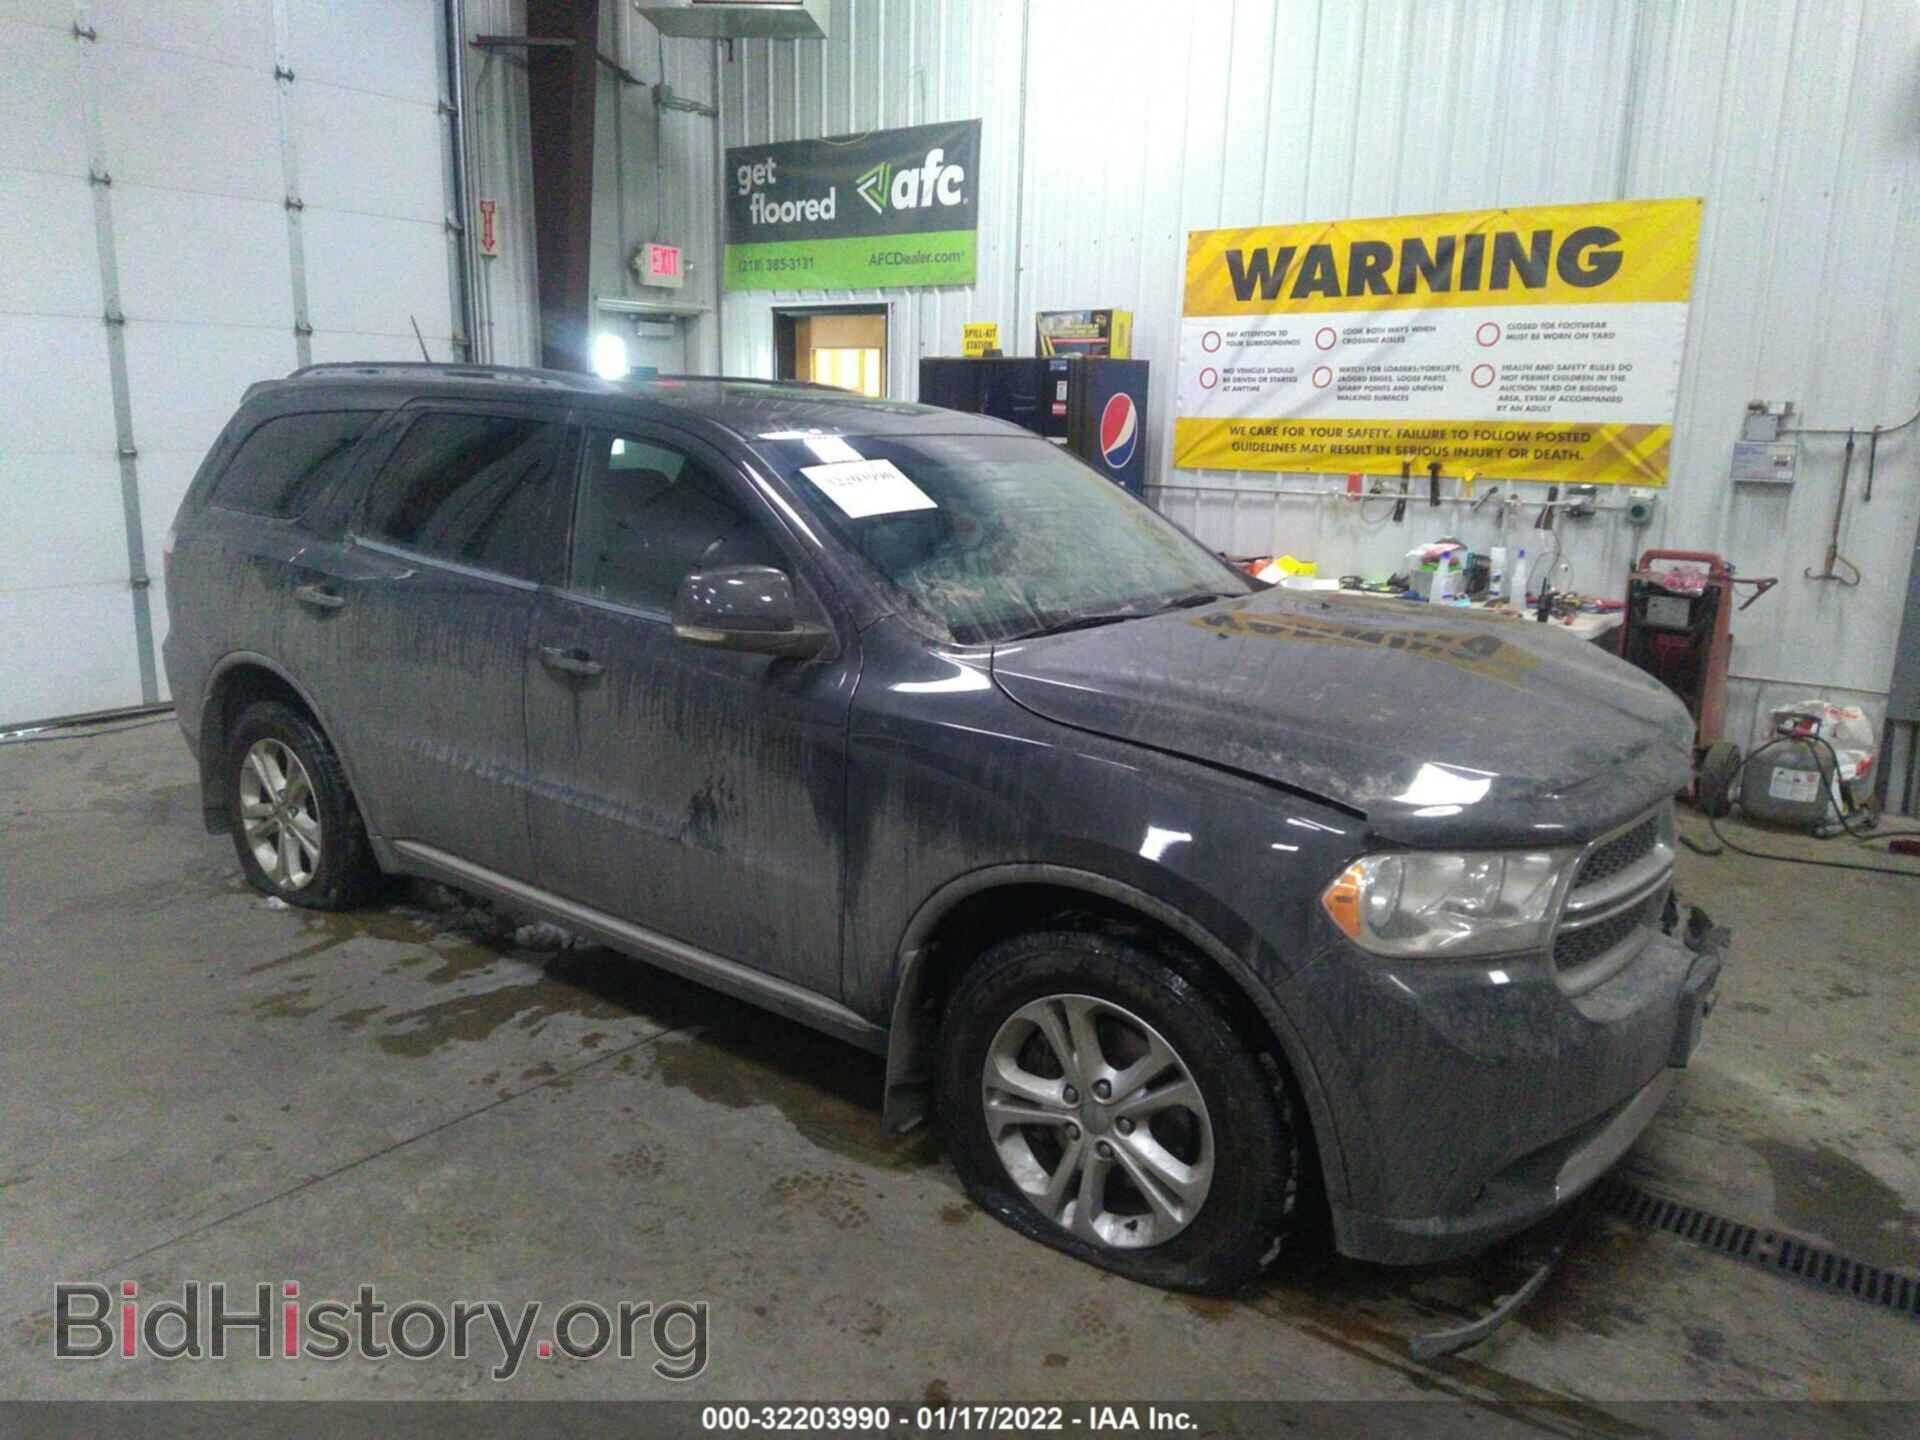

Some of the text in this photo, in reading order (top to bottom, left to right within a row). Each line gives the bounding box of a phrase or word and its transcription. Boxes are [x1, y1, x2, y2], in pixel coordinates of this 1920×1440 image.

[737, 157, 776, 195] get
[891, 149, 965, 209] afc
[750, 187, 836, 225] floored
[652, 247, 678, 274] EXIT
[868, 250, 961, 267] AFCDealer.com
[1225, 226, 1623, 300] WARNING
[1230, 426, 1590, 442] WE CARE FOR YOUR SAFETY. FAILURE TO FOLLOW POSTED
[1232, 442, 1584, 460] GUIDELINES MAY RESULT IN SERIOUS INJURY OR DEATH.
